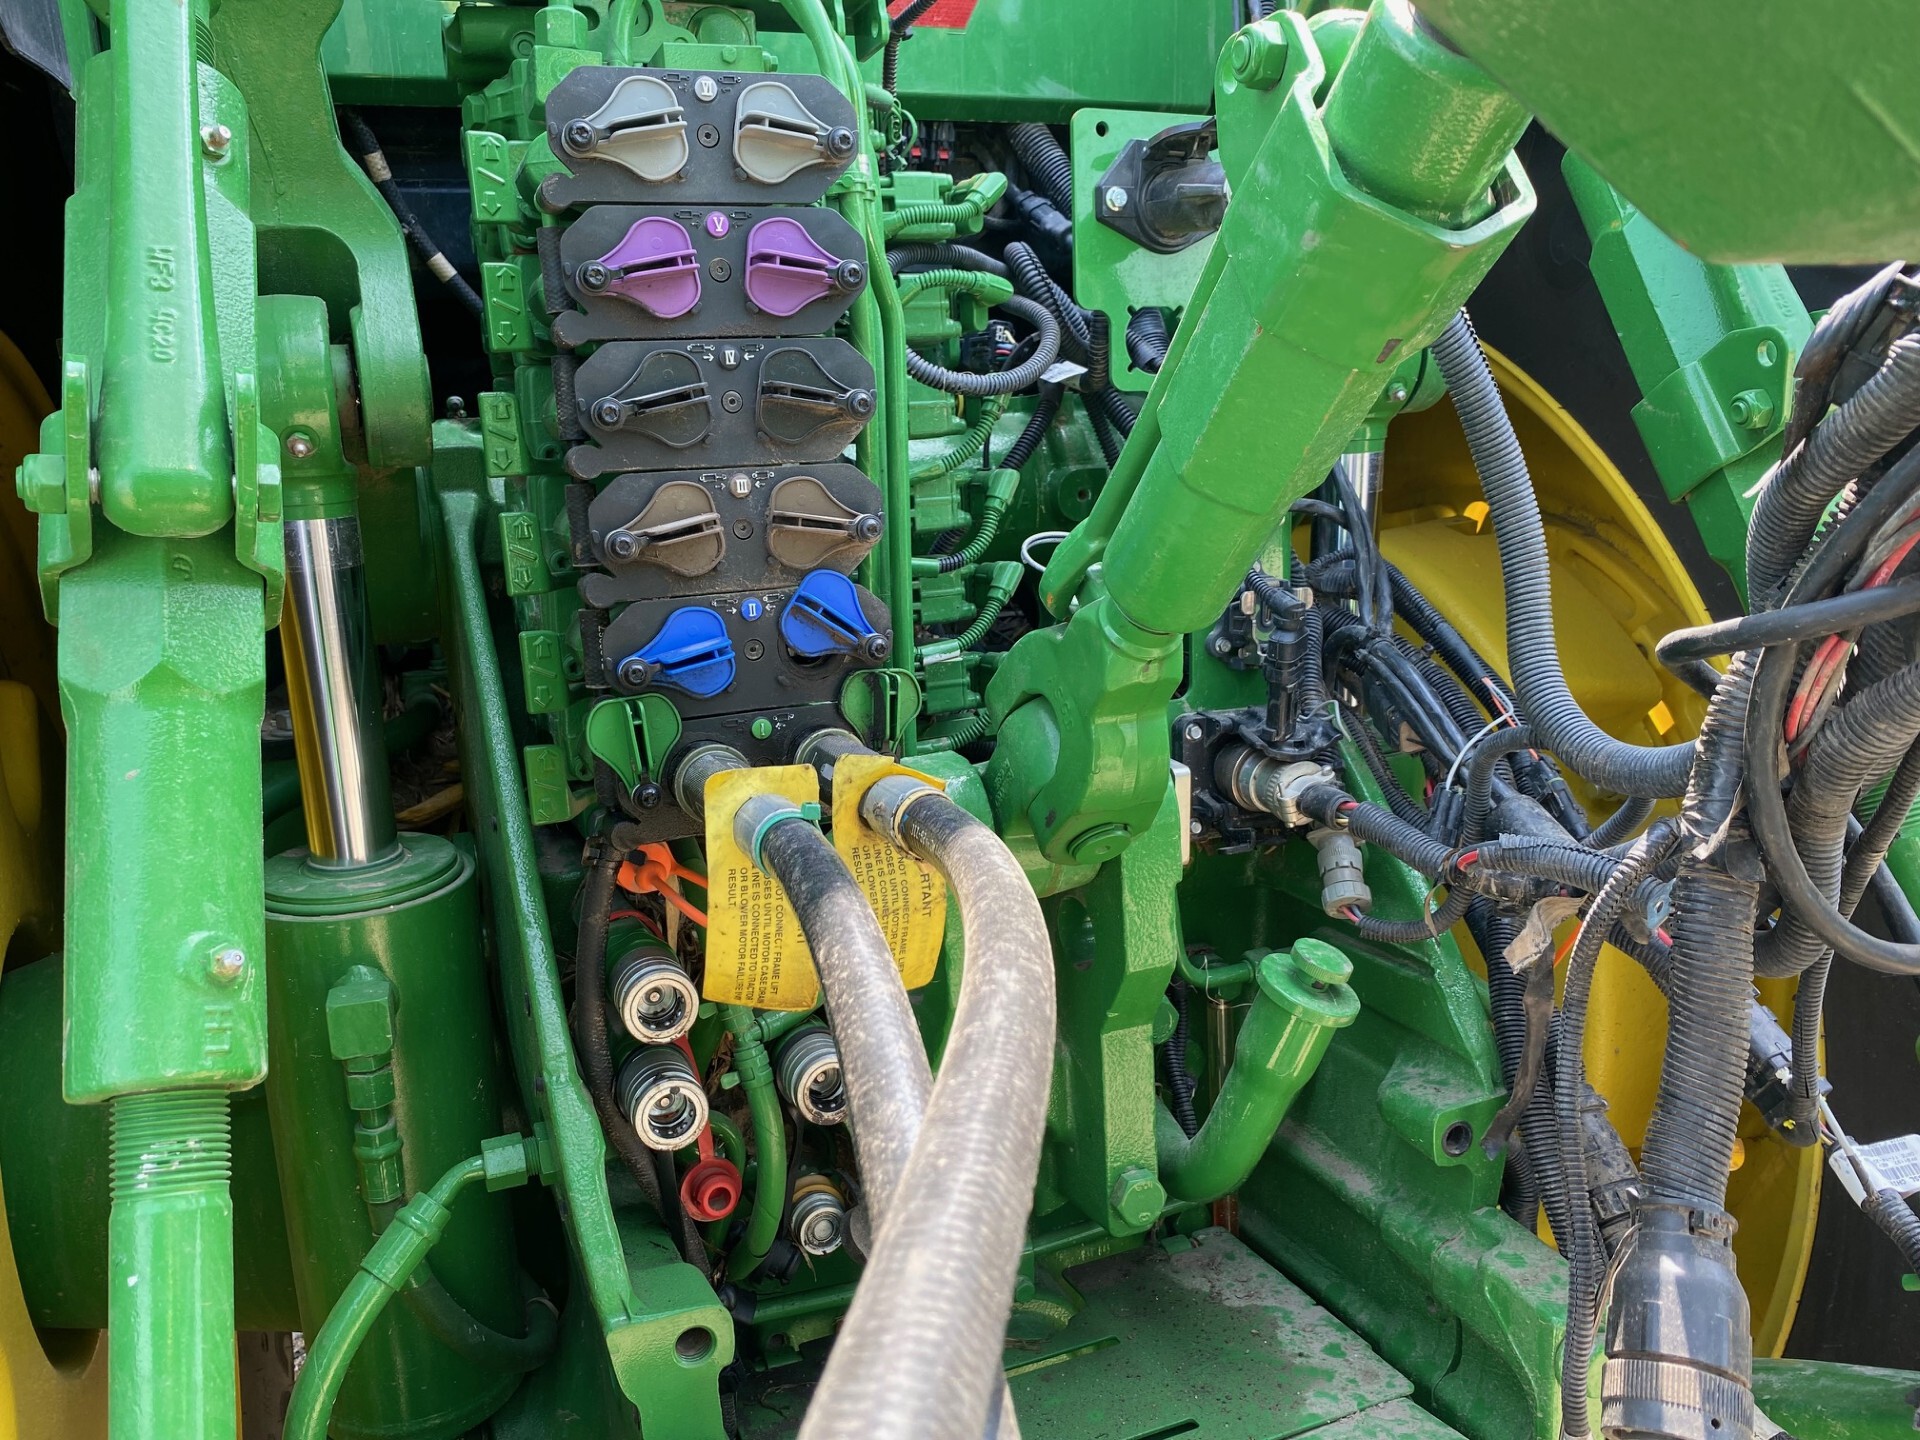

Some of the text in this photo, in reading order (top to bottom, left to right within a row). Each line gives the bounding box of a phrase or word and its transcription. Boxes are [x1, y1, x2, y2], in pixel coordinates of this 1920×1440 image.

[701, 80, 713, 96] VI
[713, 216, 724, 232] V
[724, 349, 736, 365] IV
[735, 479, 748, 494] III
[748, 603, 756, 617] II
[862, 846, 872, 860] OR
[873, 844, 884, 865] LINE
[884, 842, 896, 875] HOSES
[741, 868, 748, 882] OR
[877, 868, 885, 877] IS
[897, 857, 906, 876] NOT
[728, 869, 736, 908] RESULT.
[752, 892, 760, 901] IS
[865, 863, 878, 904] BLOWER
[890, 879, 899, 907] UNTIL
[920, 873, 932, 917] RTANT
[740, 886, 748, 927] BLOWER
[901, 880, 909, 924] CONNECT
[763, 902, 771, 929] UNTIL
[775, 905, 783, 949] CONNECT
[891, 908, 900, 940] MOTOR
[750, 904, 759, 958] CONNECTED
[899, 927, 908, 955] FRAME
[738, 930, 747, 959] MOTOR
[762, 933, 770, 963] MOTOR
[735, 962, 745, 990] FAILURE
[749, 962, 757, 971] TO
[760, 966, 768, 985] CASE
[772, 952, 781, 980] FRAME
[746, 974, 756, 1000] TRACTOR
[757, 987, 766, 1003] DRAIN
[770, 982, 779, 995] LIFT
